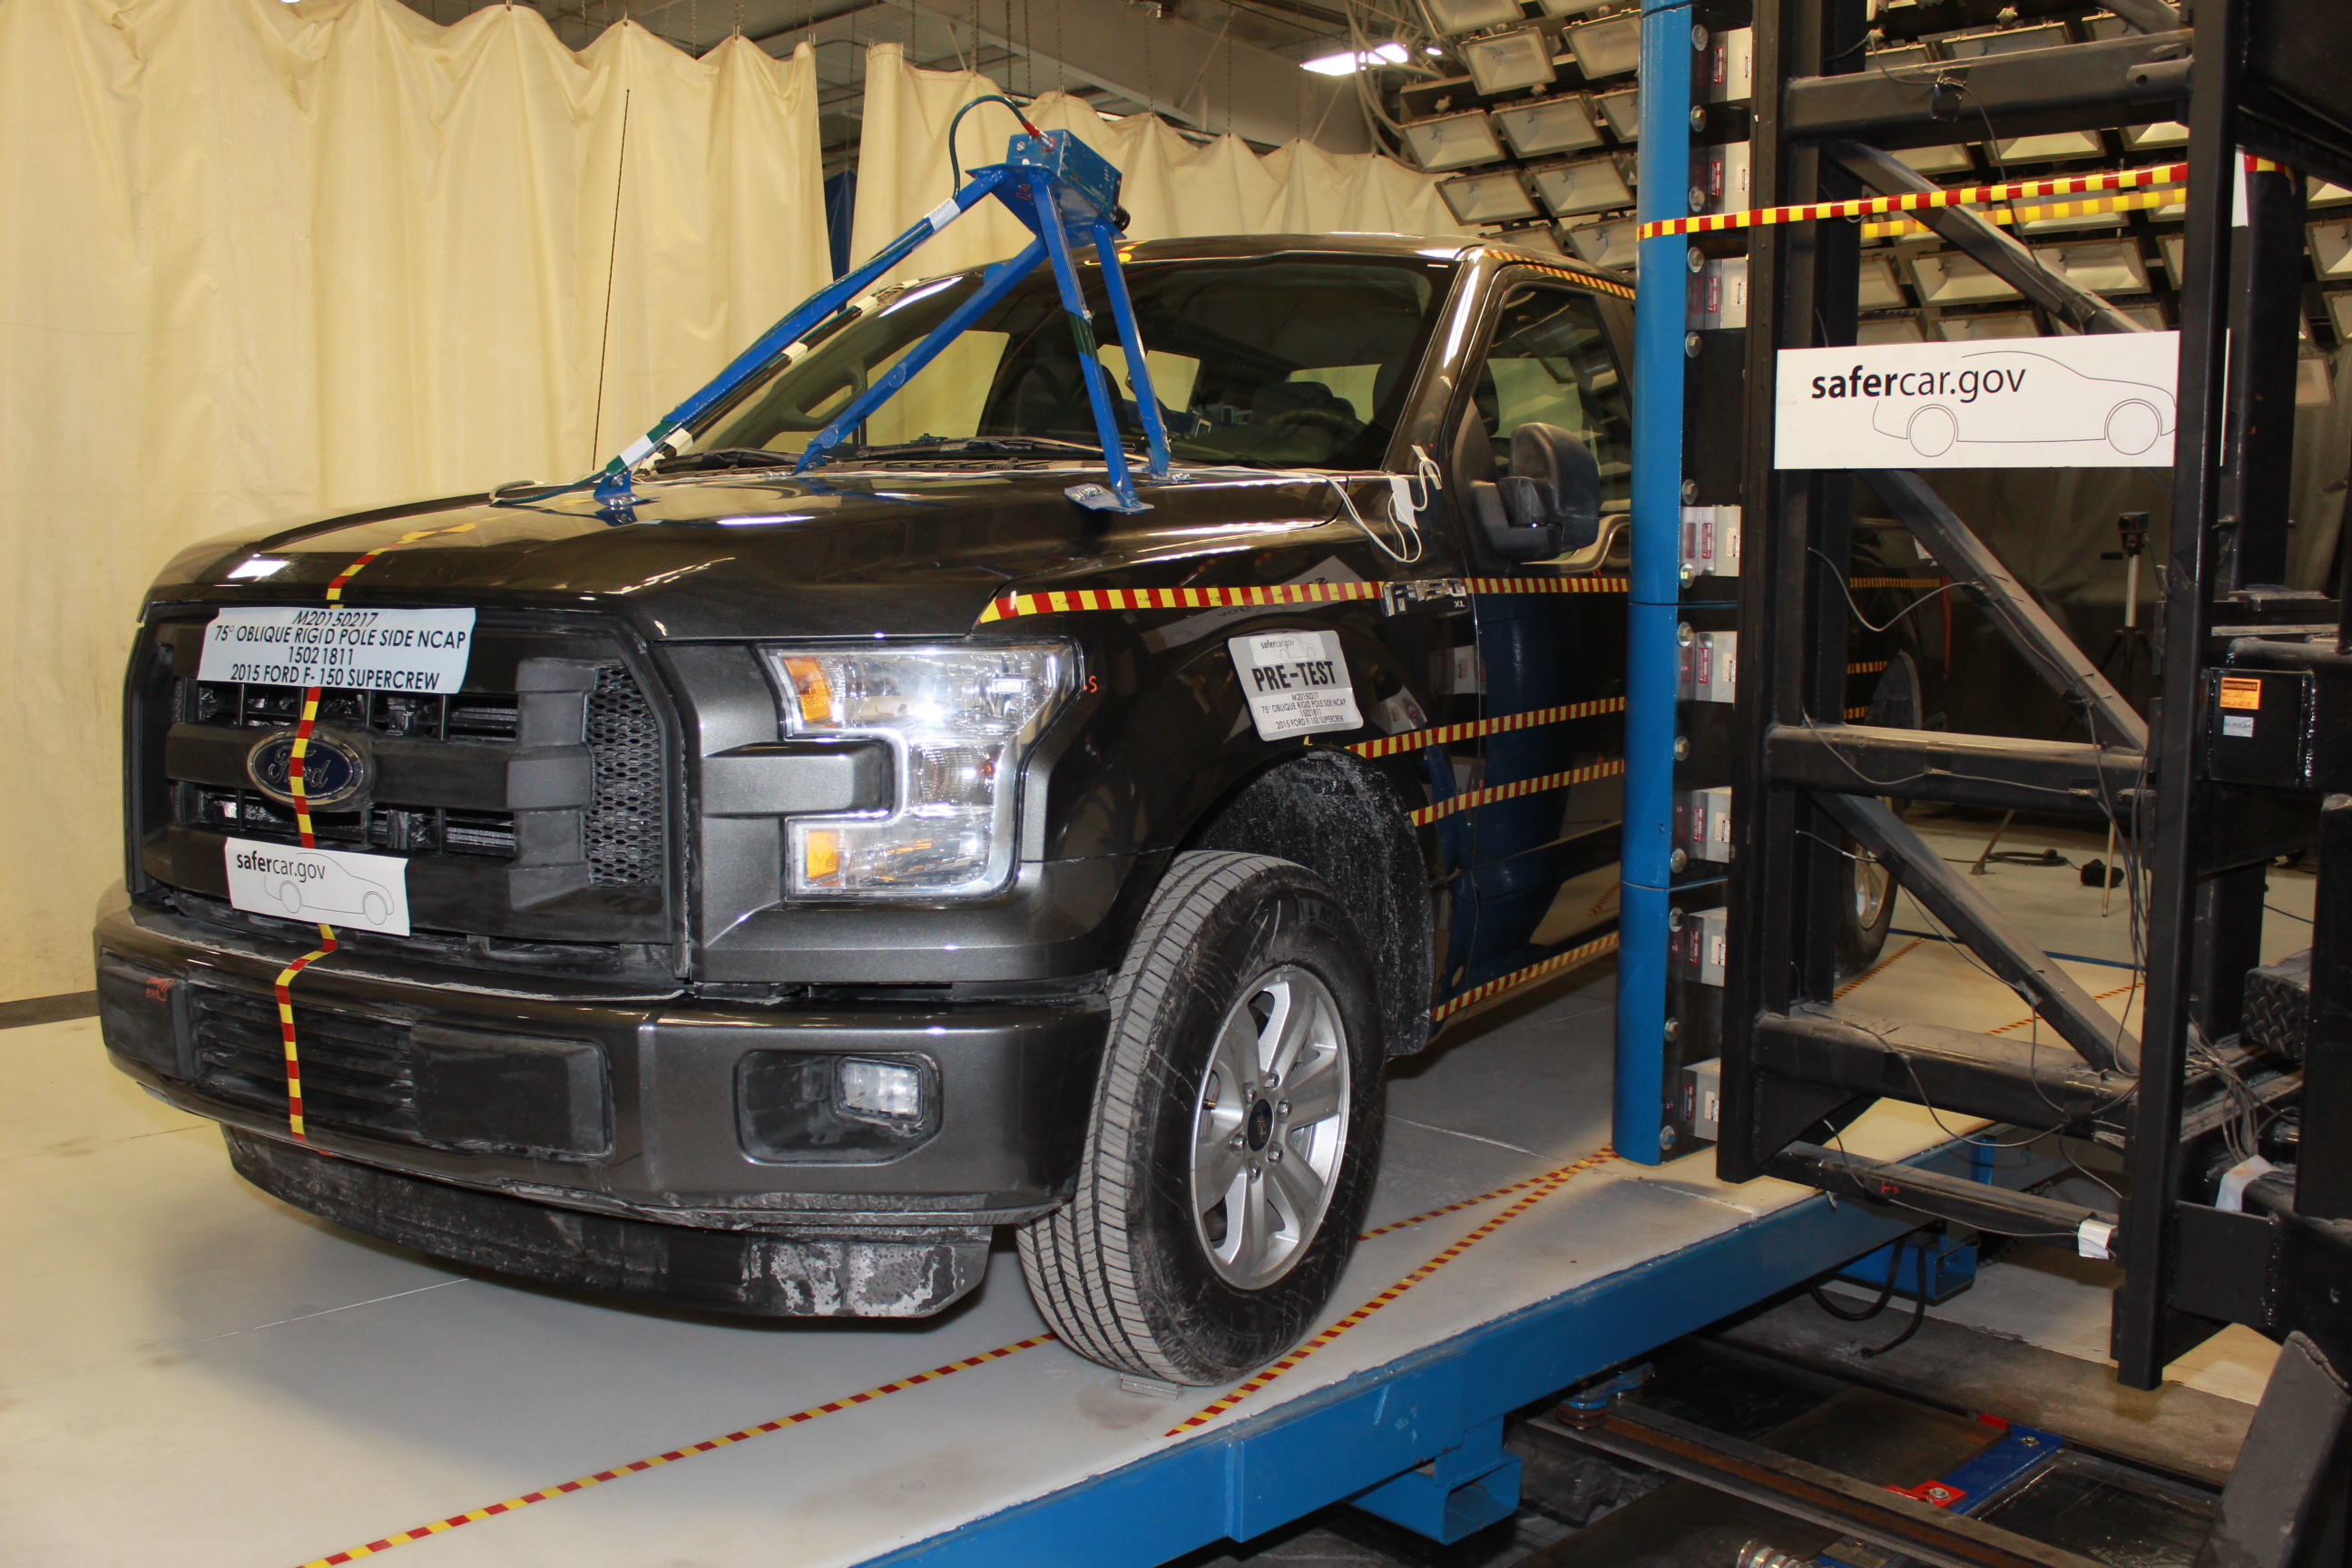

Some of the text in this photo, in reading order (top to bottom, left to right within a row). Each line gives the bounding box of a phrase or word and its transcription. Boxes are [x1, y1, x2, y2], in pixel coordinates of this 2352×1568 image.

[1811, 365, 2026, 403] safercar.gov
[1454, 600, 1466, 608] XL
[236, 625, 292, 643] OBLIQUE
[294, 627, 336, 644] RIGID
[338, 629, 377, 645] POLE
[379, 629, 415, 647] SIDE
[417, 630, 466, 650] NCAP
[1260, 639, 1295, 650] safercar.gov
[230, 663, 261, 681] 2015
[263, 665, 299, 683] FORD
[348, 669, 440, 691] SUPERCREW
[1251, 661, 1336, 691] PRE-TEST
[1271, 702, 1297, 712] OBLIQUE
[1297, 701, 1311, 710] RIGID
[1311, 700, 1324, 709] POLE
[1333, 698, 1346, 707] NCAP
[1276, 720, 1291, 730] 2015
[1290, 718, 1307, 728] FORD
[237, 850, 326, 883] safercar.gov
